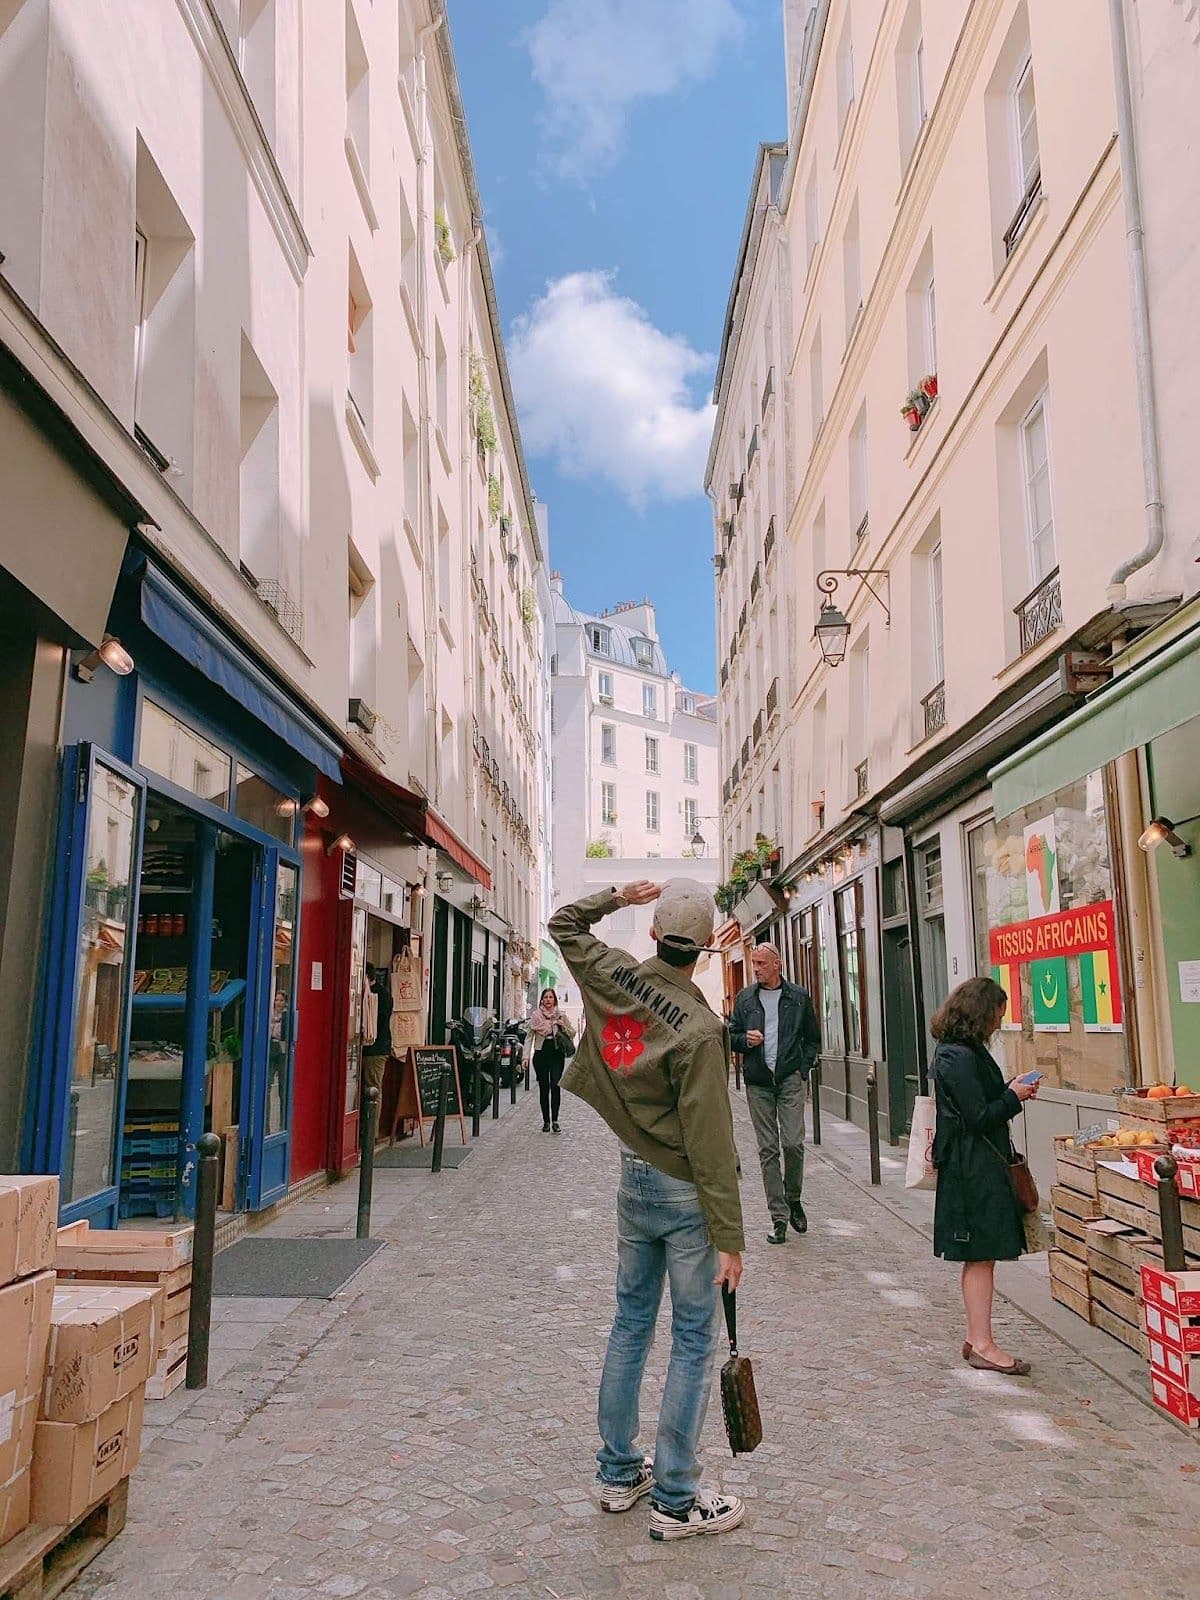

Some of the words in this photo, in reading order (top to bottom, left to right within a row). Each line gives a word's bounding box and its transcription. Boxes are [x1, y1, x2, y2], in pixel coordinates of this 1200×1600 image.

[996, 927, 1034, 958] TISSUS
[1036, 911, 1108, 952] AFRICAINS
[610, 965, 655, 1004] HUMAN
[100, 1437, 121, 1459] IKEA
